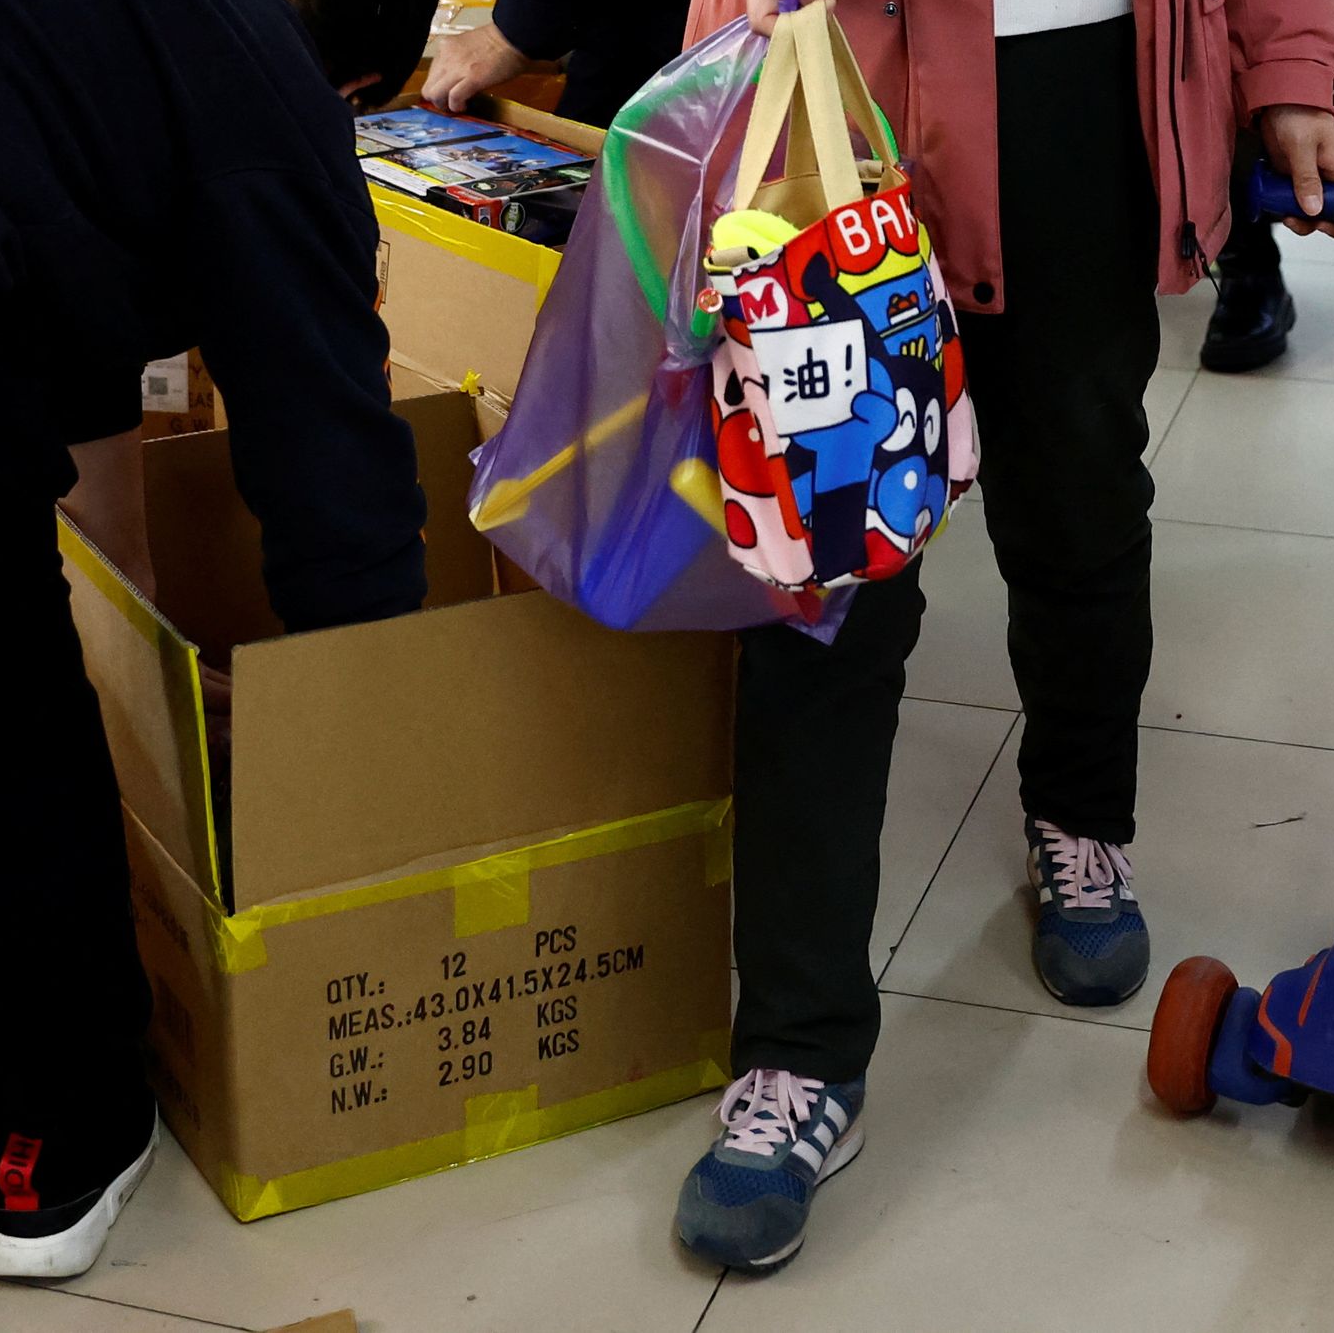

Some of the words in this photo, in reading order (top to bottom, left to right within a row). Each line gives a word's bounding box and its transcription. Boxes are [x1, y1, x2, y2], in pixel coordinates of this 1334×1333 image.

[327, 972, 385, 1005] QTY.:
[441, 951, 467, 981] 12
[535, 925, 577, 958] PCS
[329, 1045, 385, 1078] G.W.:
[438, 1016, 492, 1052] 3.84
[537, 995, 578, 1028] KGS
[331, 1080, 389, 1115] N.W.:
[438, 1050, 493, 1087] 2.90
[538, 1029, 580, 1061] KGS
